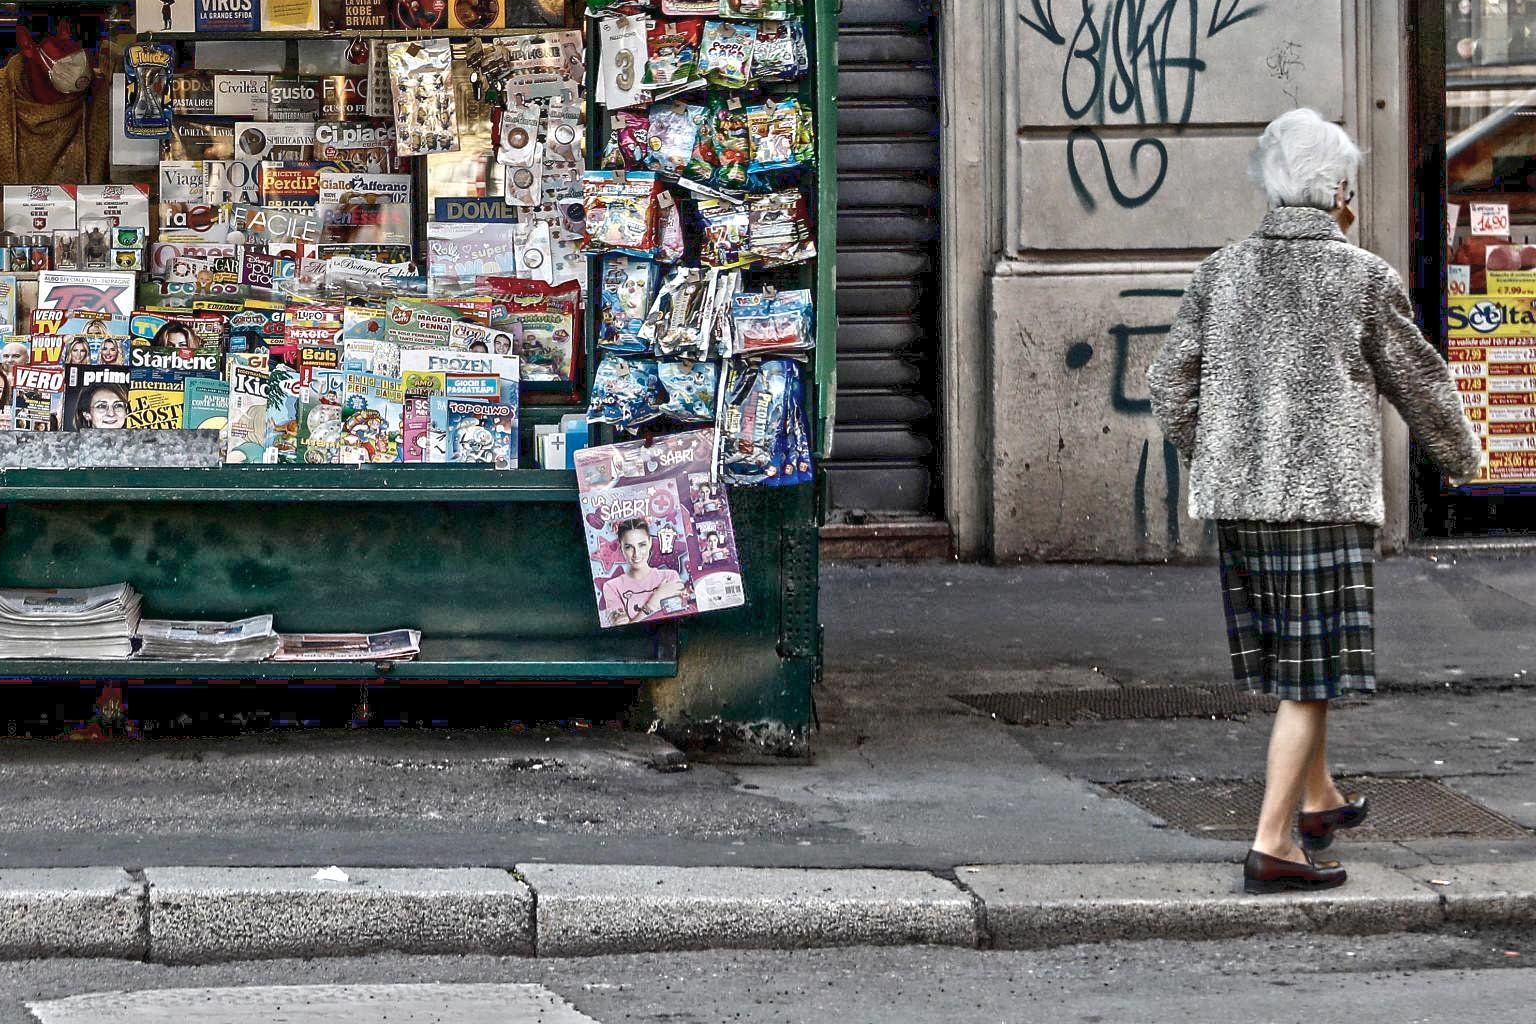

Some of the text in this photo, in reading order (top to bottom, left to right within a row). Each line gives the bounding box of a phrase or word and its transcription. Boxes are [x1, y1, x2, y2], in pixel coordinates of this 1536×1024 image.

[208, 11, 233, 19] GRANDE
[234, 11, 253, 19] SFIDA
[345, 6, 372, 16] KOBE
[345, 16, 385, 26] BRYANT
[271, 85, 315, 104] gusto
[233, 208, 318, 242] FACILE
[34, 310, 63, 321] VERO
[417, 313, 452, 324] MAGICA
[36, 321, 61, 336] TV
[420, 322, 449, 330] PENNA
[32, 338, 63, 348] NUOVO
[32, 347, 62, 363] TV
[132, 346, 215, 371] Starbene
[428, 355, 493, 372] FROZEN
[17, 369, 63, 390] VERO
[449, 403, 510, 416] TOPOLINO
[600, 497, 650, 521] SABRI
